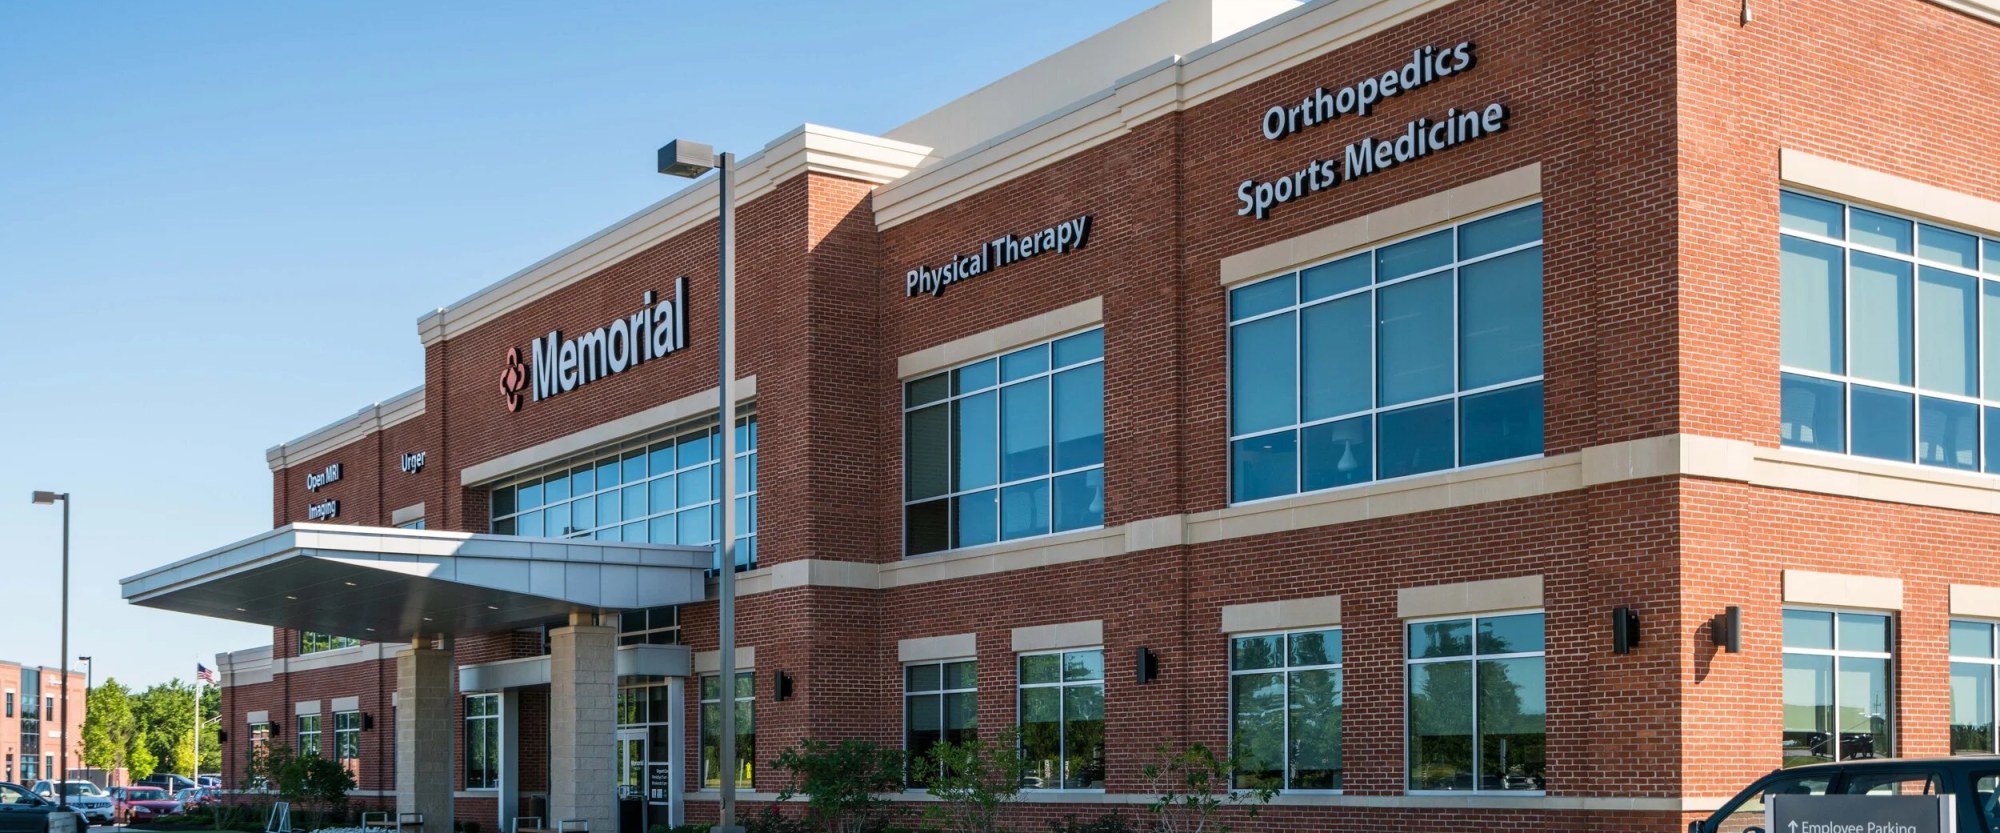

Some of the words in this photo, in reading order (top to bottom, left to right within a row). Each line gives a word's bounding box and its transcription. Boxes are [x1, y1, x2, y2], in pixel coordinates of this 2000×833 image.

[1262, 41, 1472, 140] Orthopedics
[1237, 158, 1336, 219] Sports
[1344, 102, 1505, 181] Medicine
[906, 243, 988, 297] Physical
[992, 215, 1088, 267] Therapy
[532, 276, 685, 402] Memorial
[307, 473, 326, 492] Open
[326, 463, 340, 484] MRI
[309, 499, 337, 520] Imaging
